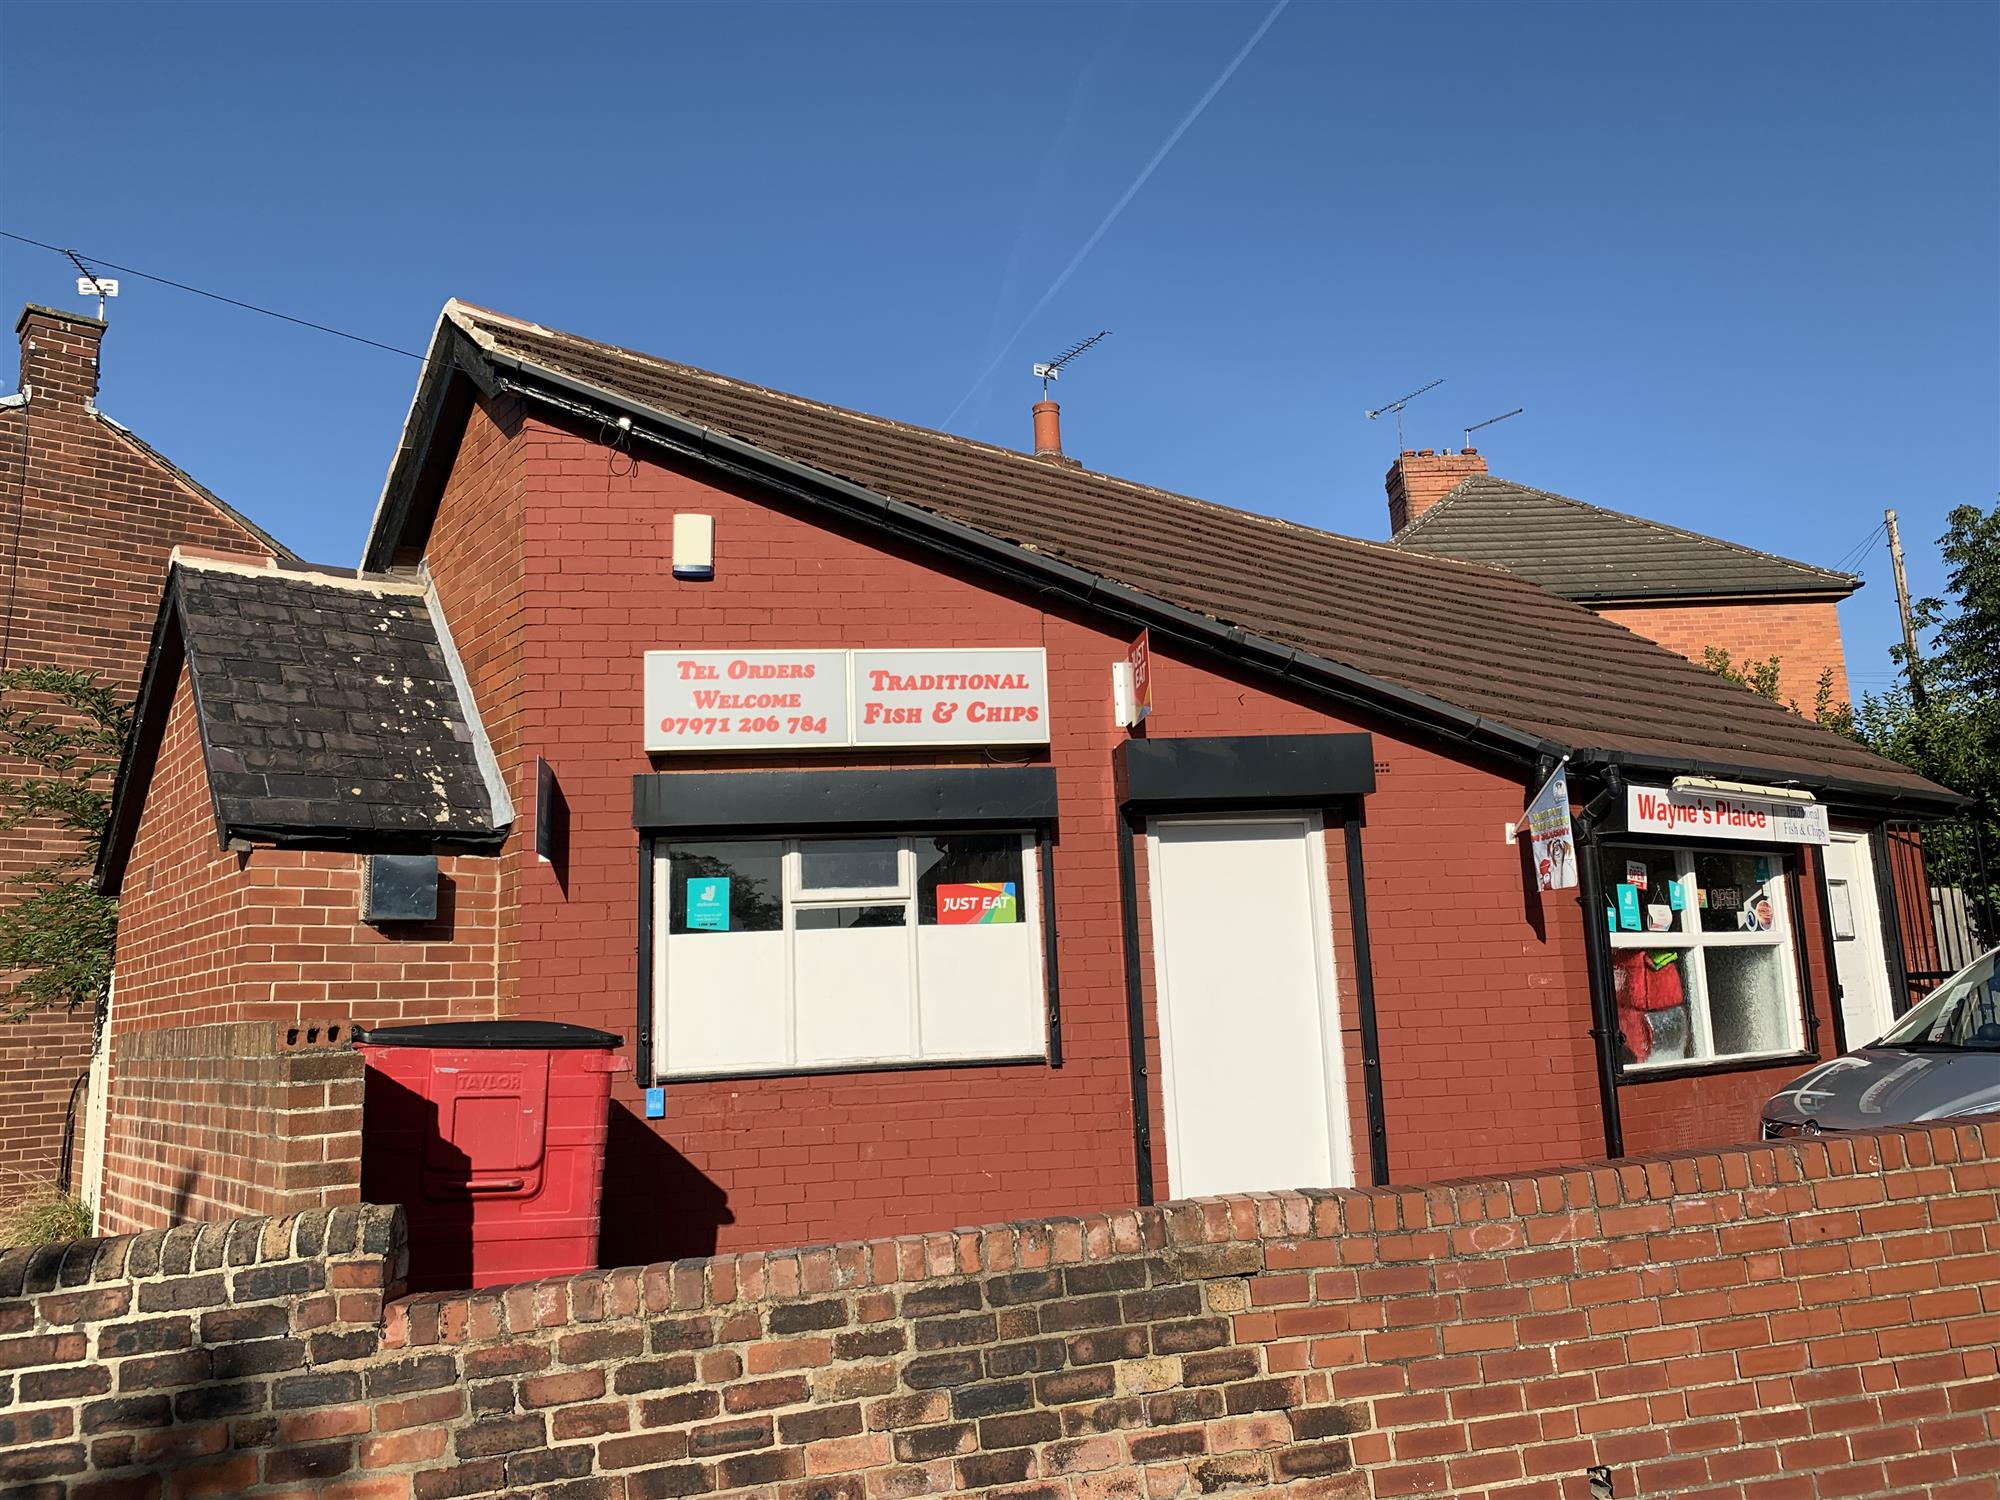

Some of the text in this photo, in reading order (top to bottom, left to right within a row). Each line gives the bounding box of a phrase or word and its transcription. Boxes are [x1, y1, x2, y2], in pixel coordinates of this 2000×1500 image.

[1136, 661, 1146, 688] EAT
[932, 701, 958, 724] &
[660, 715, 827, 735] 07971 206 784
[1637, 793, 1766, 829] Wayne's Plaice
[1800, 826, 1806, 836] &
[1629, 868, 1645, 880] OPEN
[942, 896, 1010, 913] JUST EAT
[458, 1073, 520, 1090] TAYLOR
